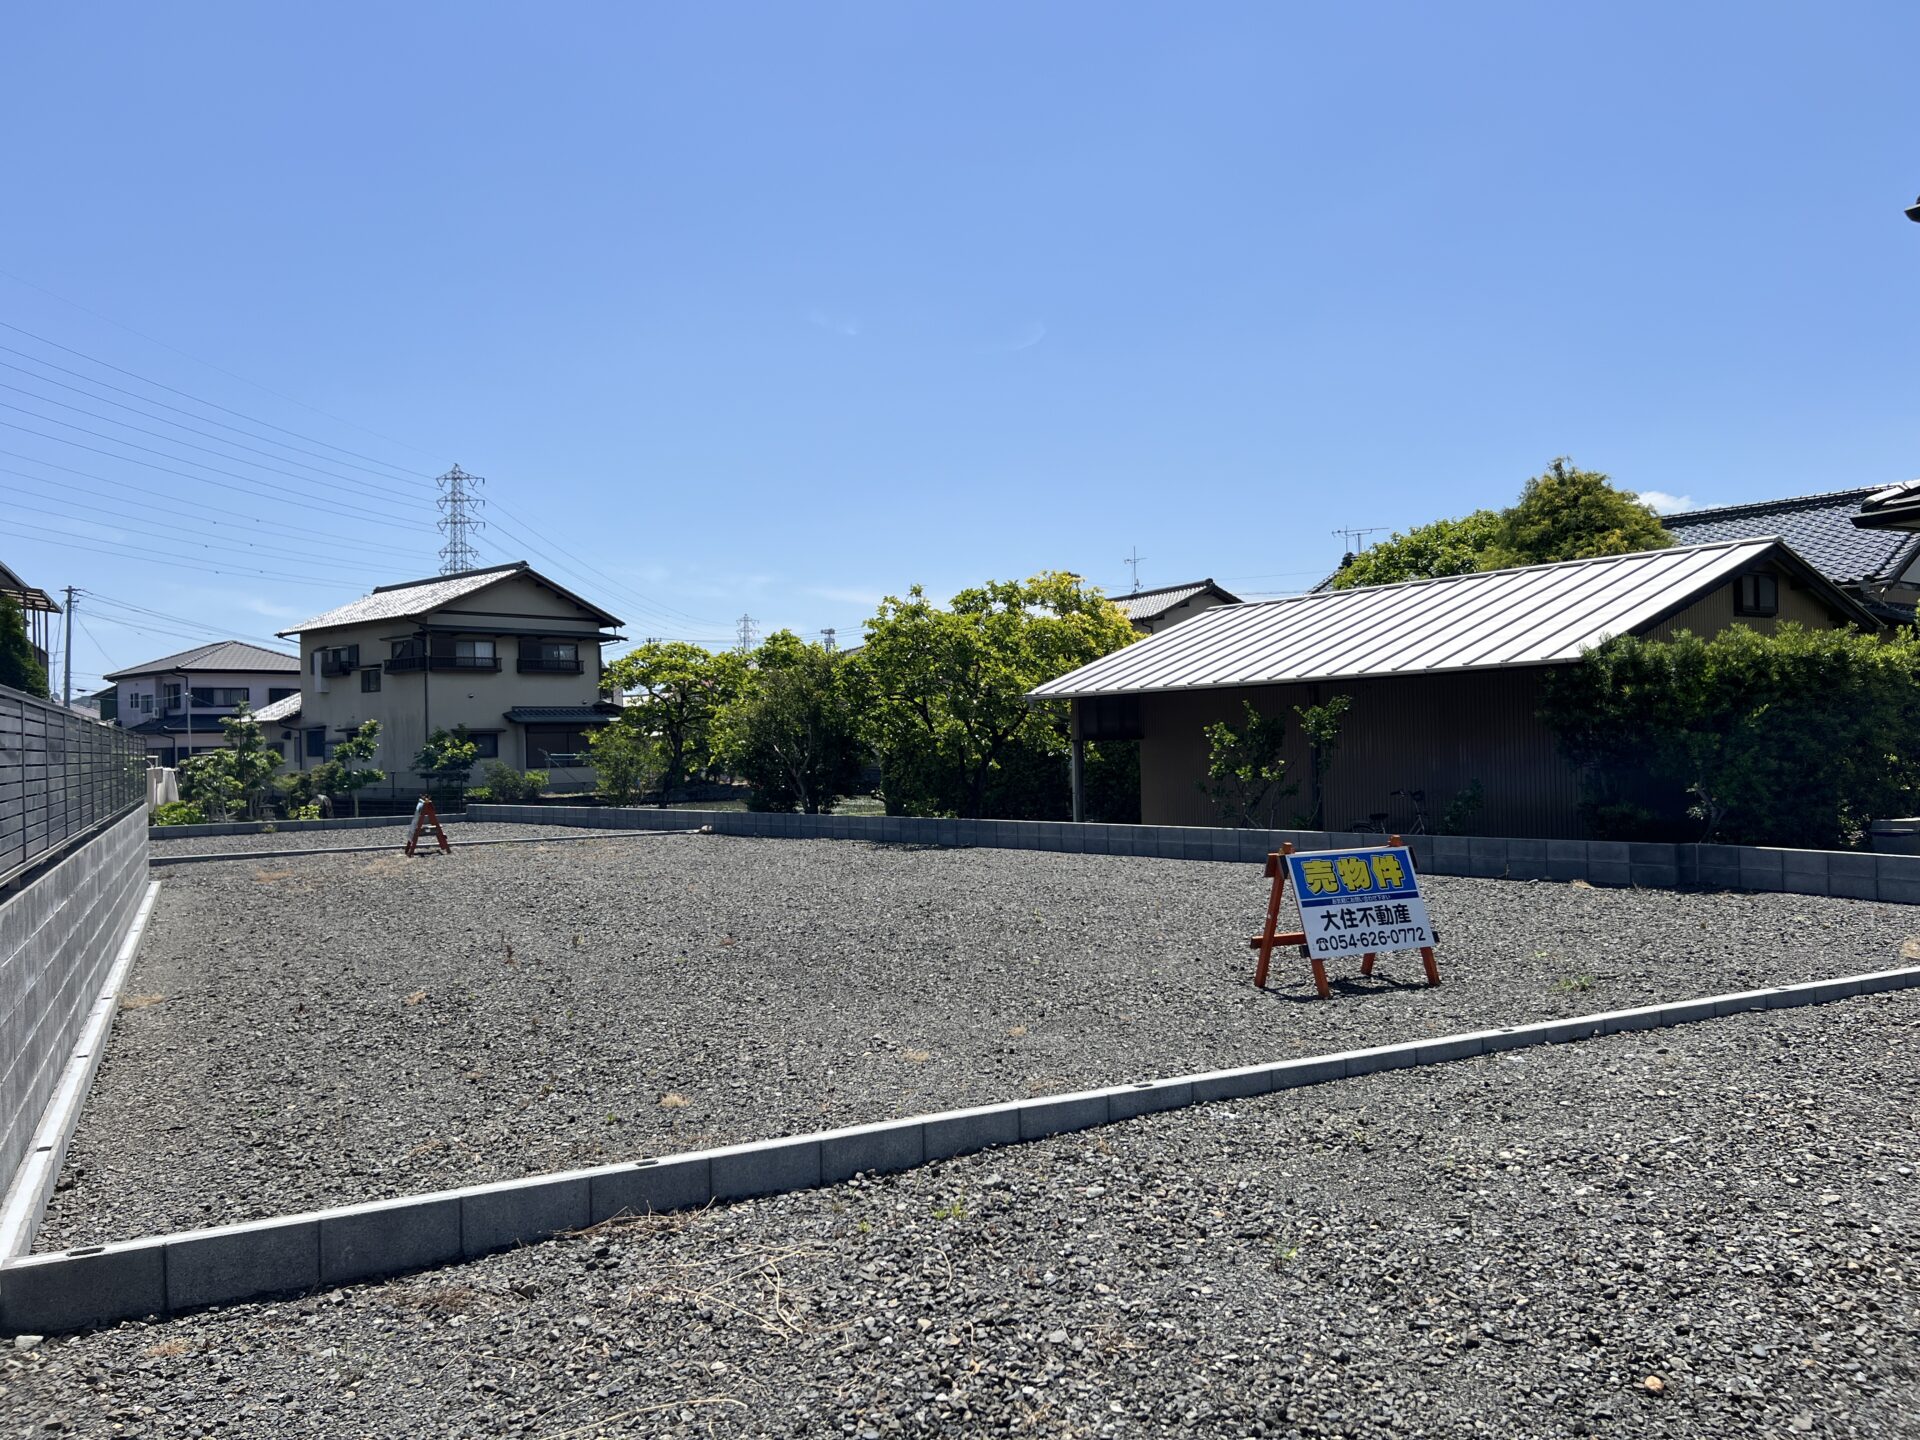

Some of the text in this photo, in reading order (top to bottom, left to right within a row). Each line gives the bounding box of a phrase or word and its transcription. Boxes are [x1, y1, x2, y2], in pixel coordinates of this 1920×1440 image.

[1302, 855, 1404, 894] 売物件
[1321, 904, 1411, 931] 大住不動産
[1330, 927, 1425, 950] 054-626-0772
